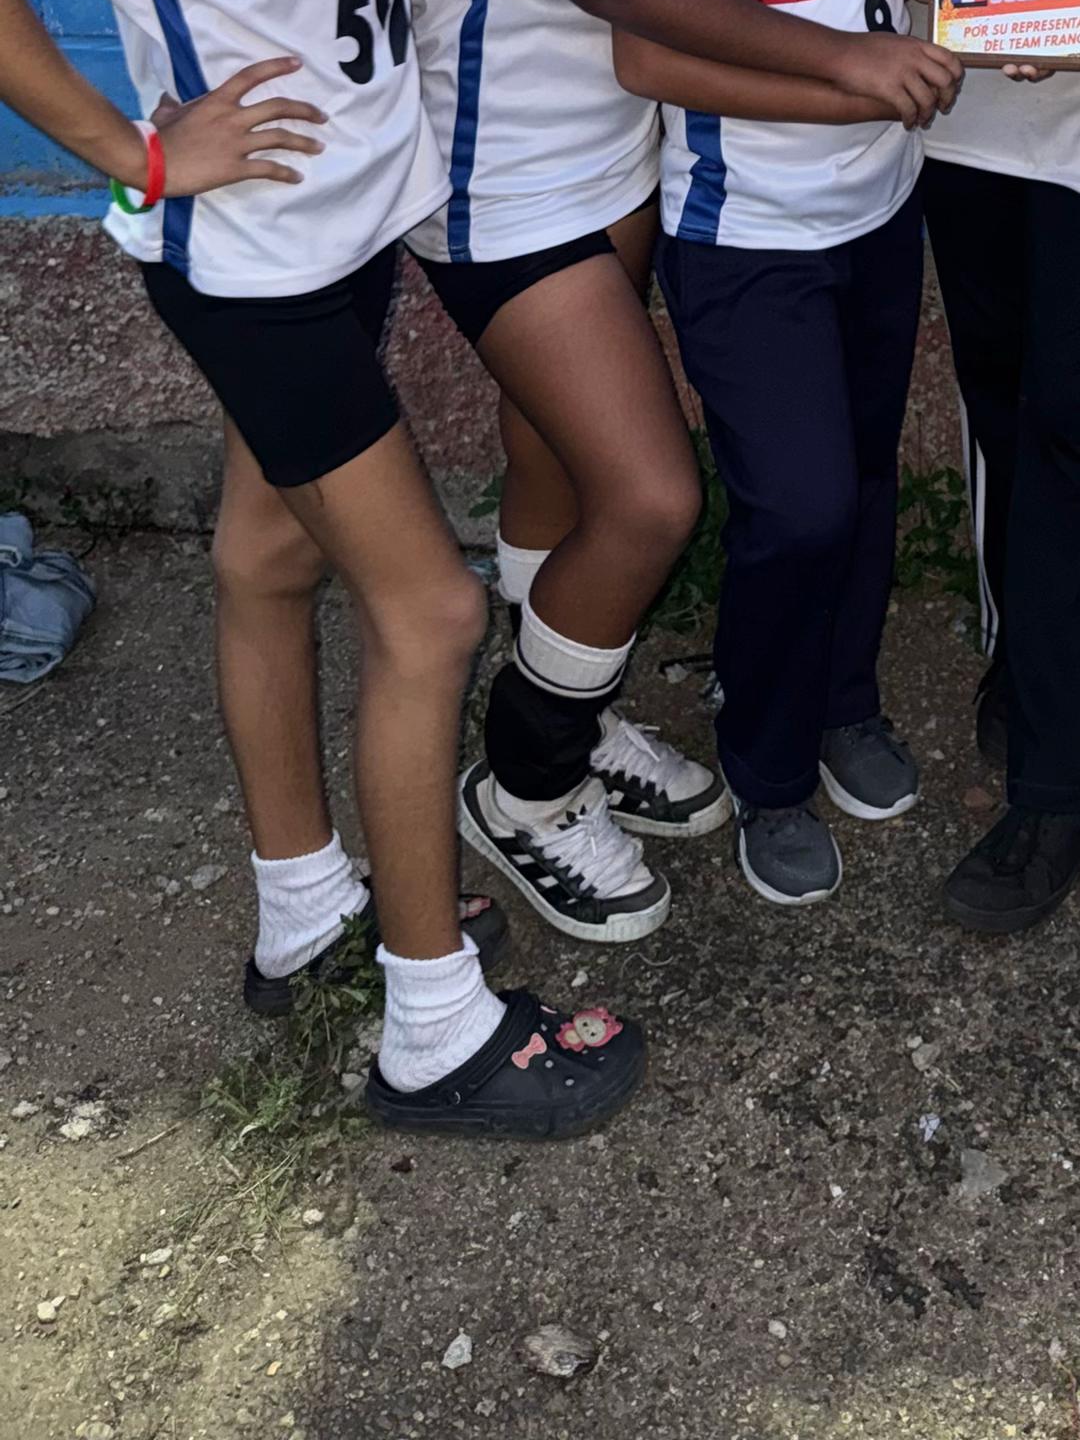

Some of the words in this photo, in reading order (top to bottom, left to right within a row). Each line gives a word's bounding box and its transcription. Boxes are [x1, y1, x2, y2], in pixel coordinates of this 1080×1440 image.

[963, 25, 989, 38] POR
[992, 23, 1008, 35] SU
[984, 39, 1004, 52] DEL
[1009, 35, 1041, 50] TEAM
